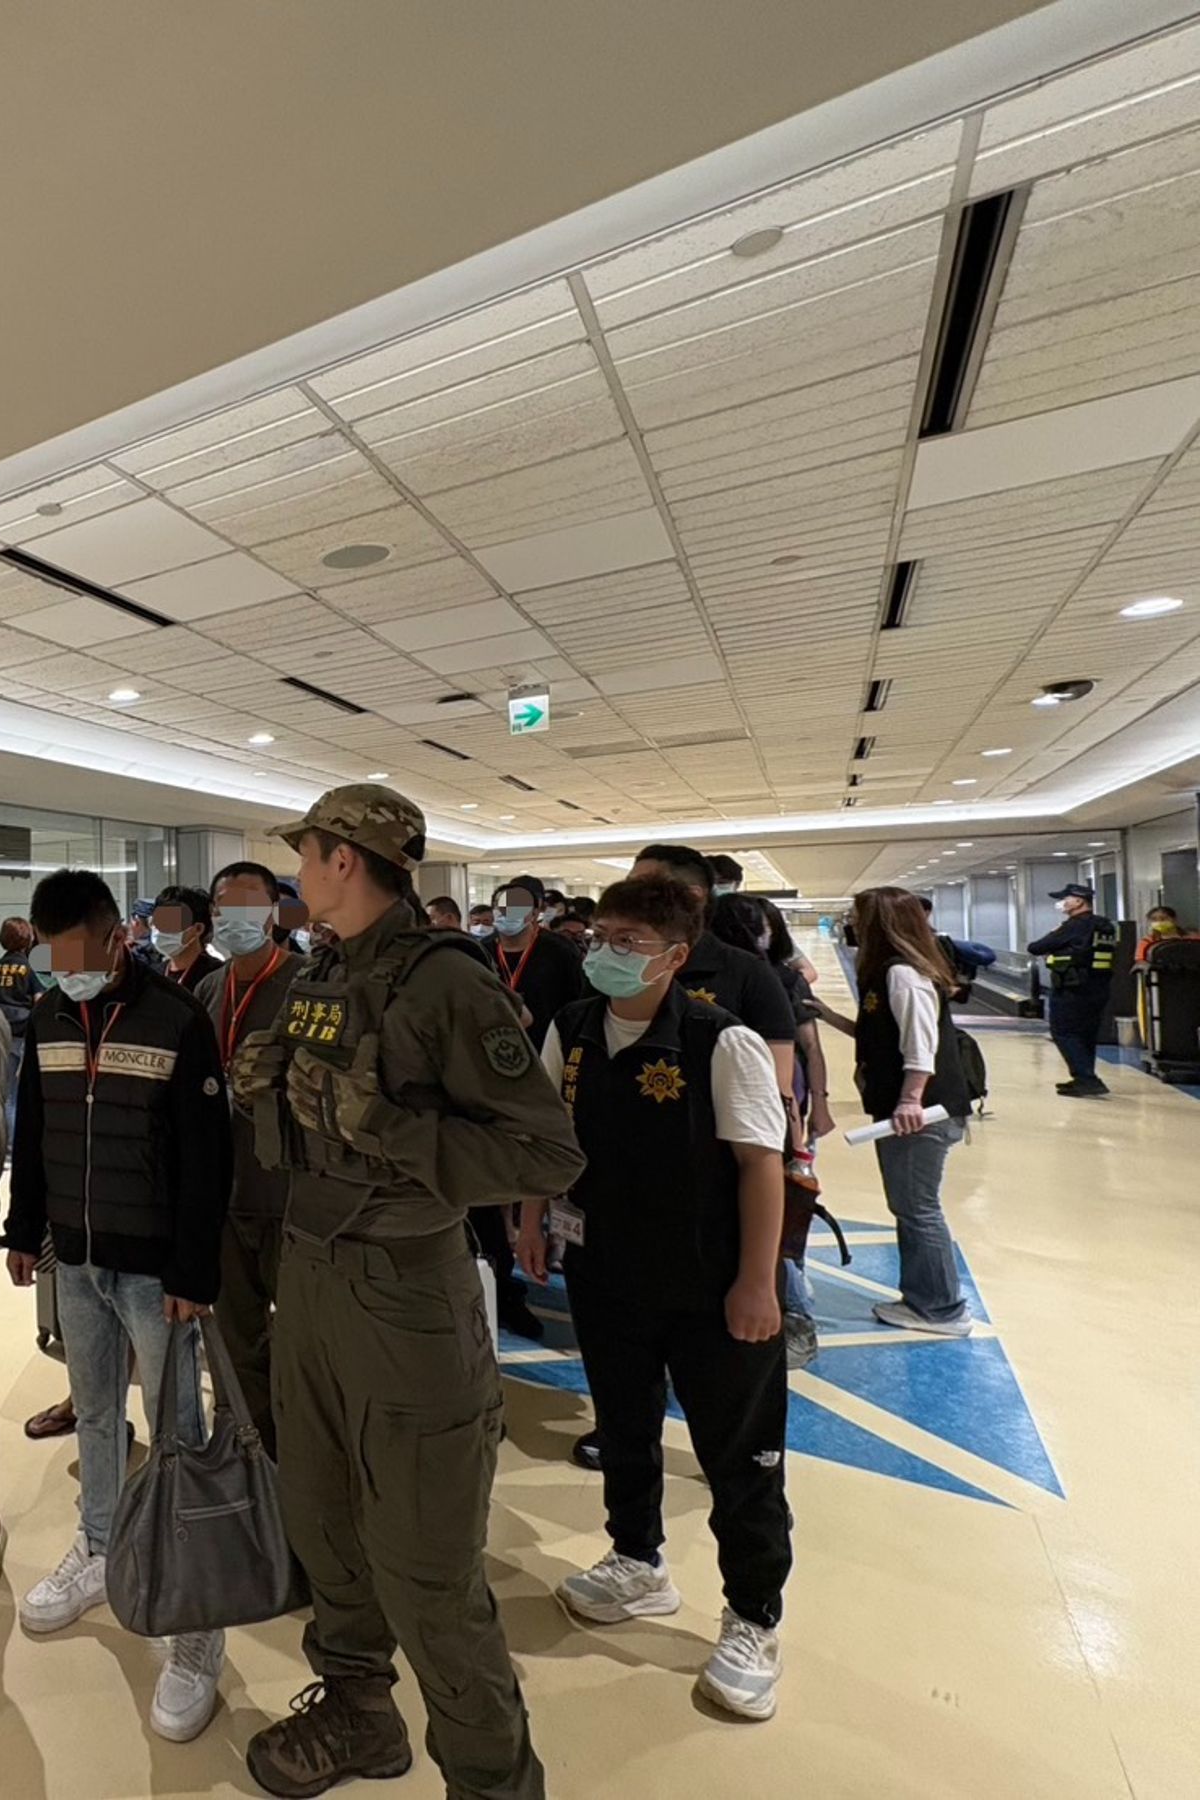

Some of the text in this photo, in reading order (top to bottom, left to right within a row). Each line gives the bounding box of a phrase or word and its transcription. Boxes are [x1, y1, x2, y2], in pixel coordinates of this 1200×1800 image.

[290, 1000, 342, 1026] 刑事局
[287, 1021, 337, 1040] CIB
[103, 1050, 167, 1070] MONCLER
